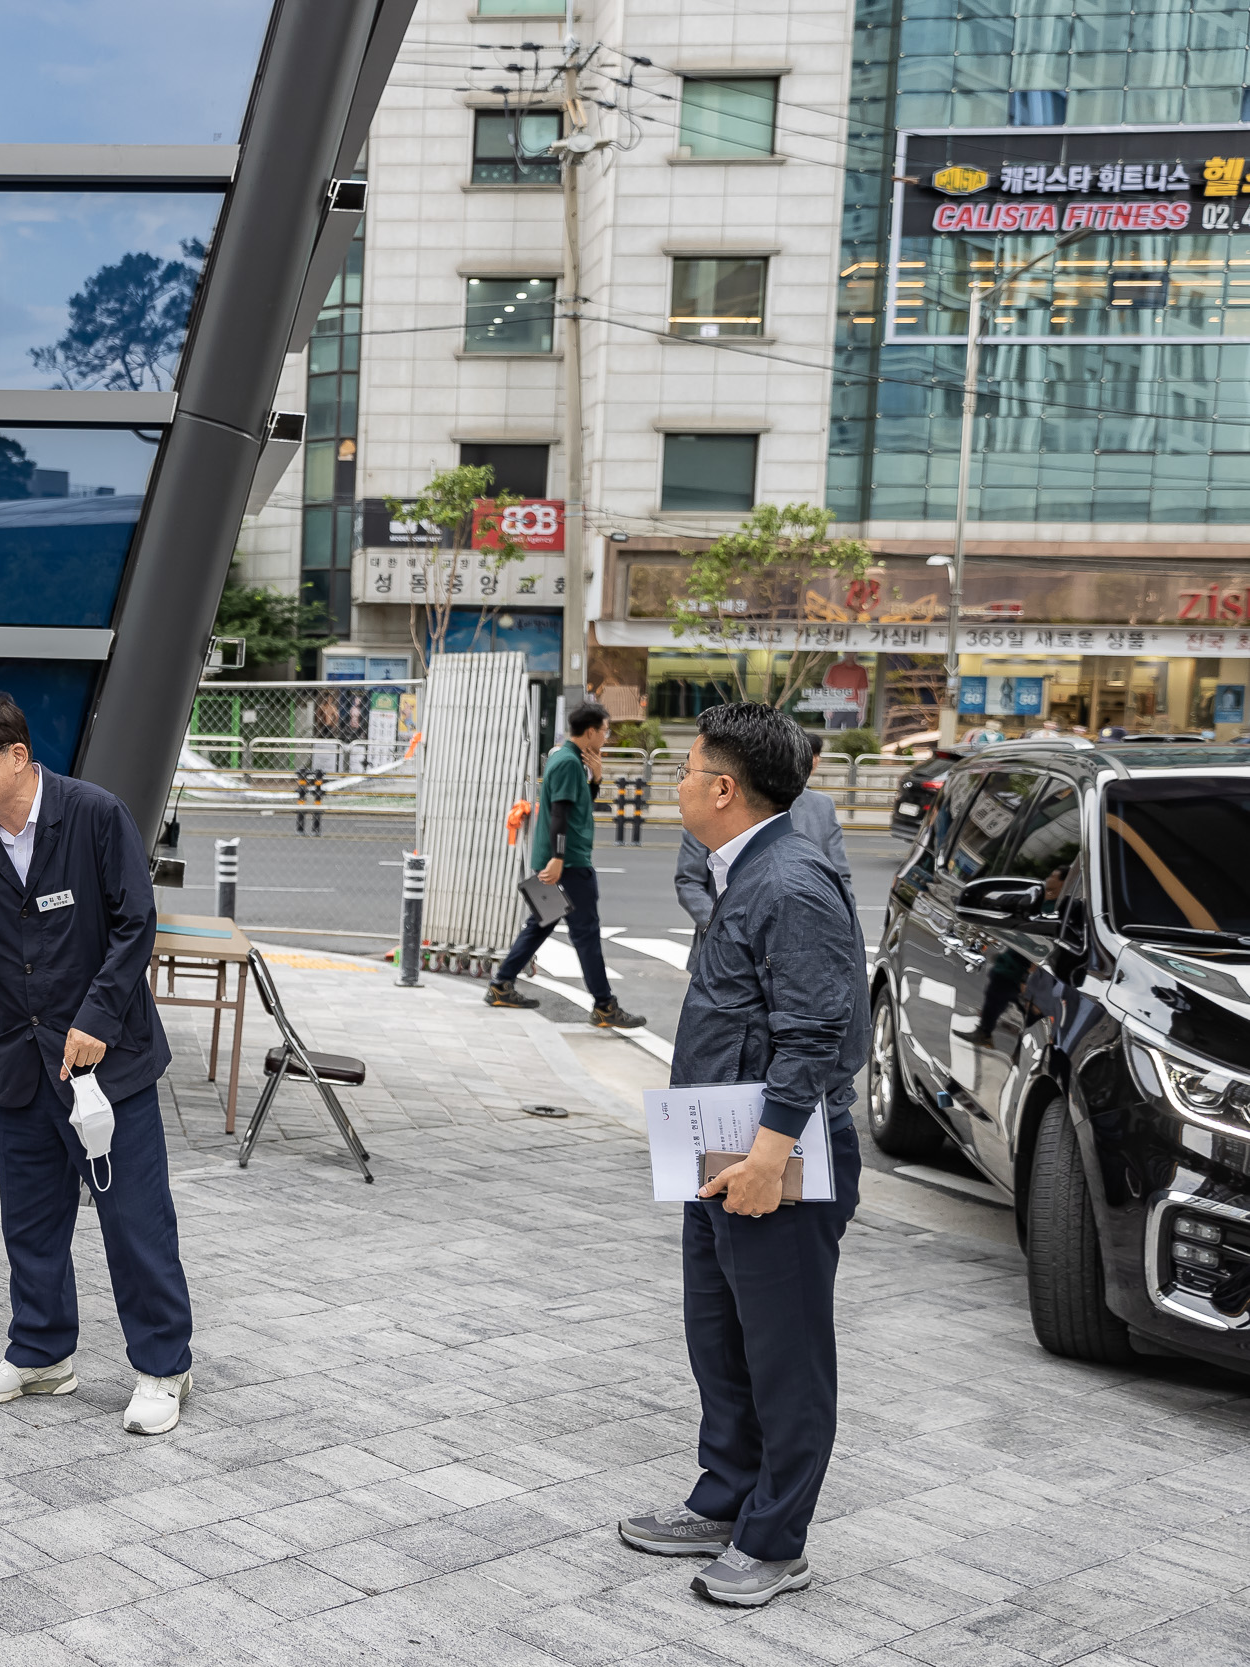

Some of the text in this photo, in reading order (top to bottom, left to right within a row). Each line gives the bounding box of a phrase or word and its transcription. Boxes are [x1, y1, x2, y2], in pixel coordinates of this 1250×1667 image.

[1001, 157, 1250, 196] 캐리스타 휘트니스 헬
[934, 202, 1190, 231] CALISTA FITNESS
[1178, 585, 1250, 619] zis
[965, 630, 1146, 650] 365일 새로운 상품
